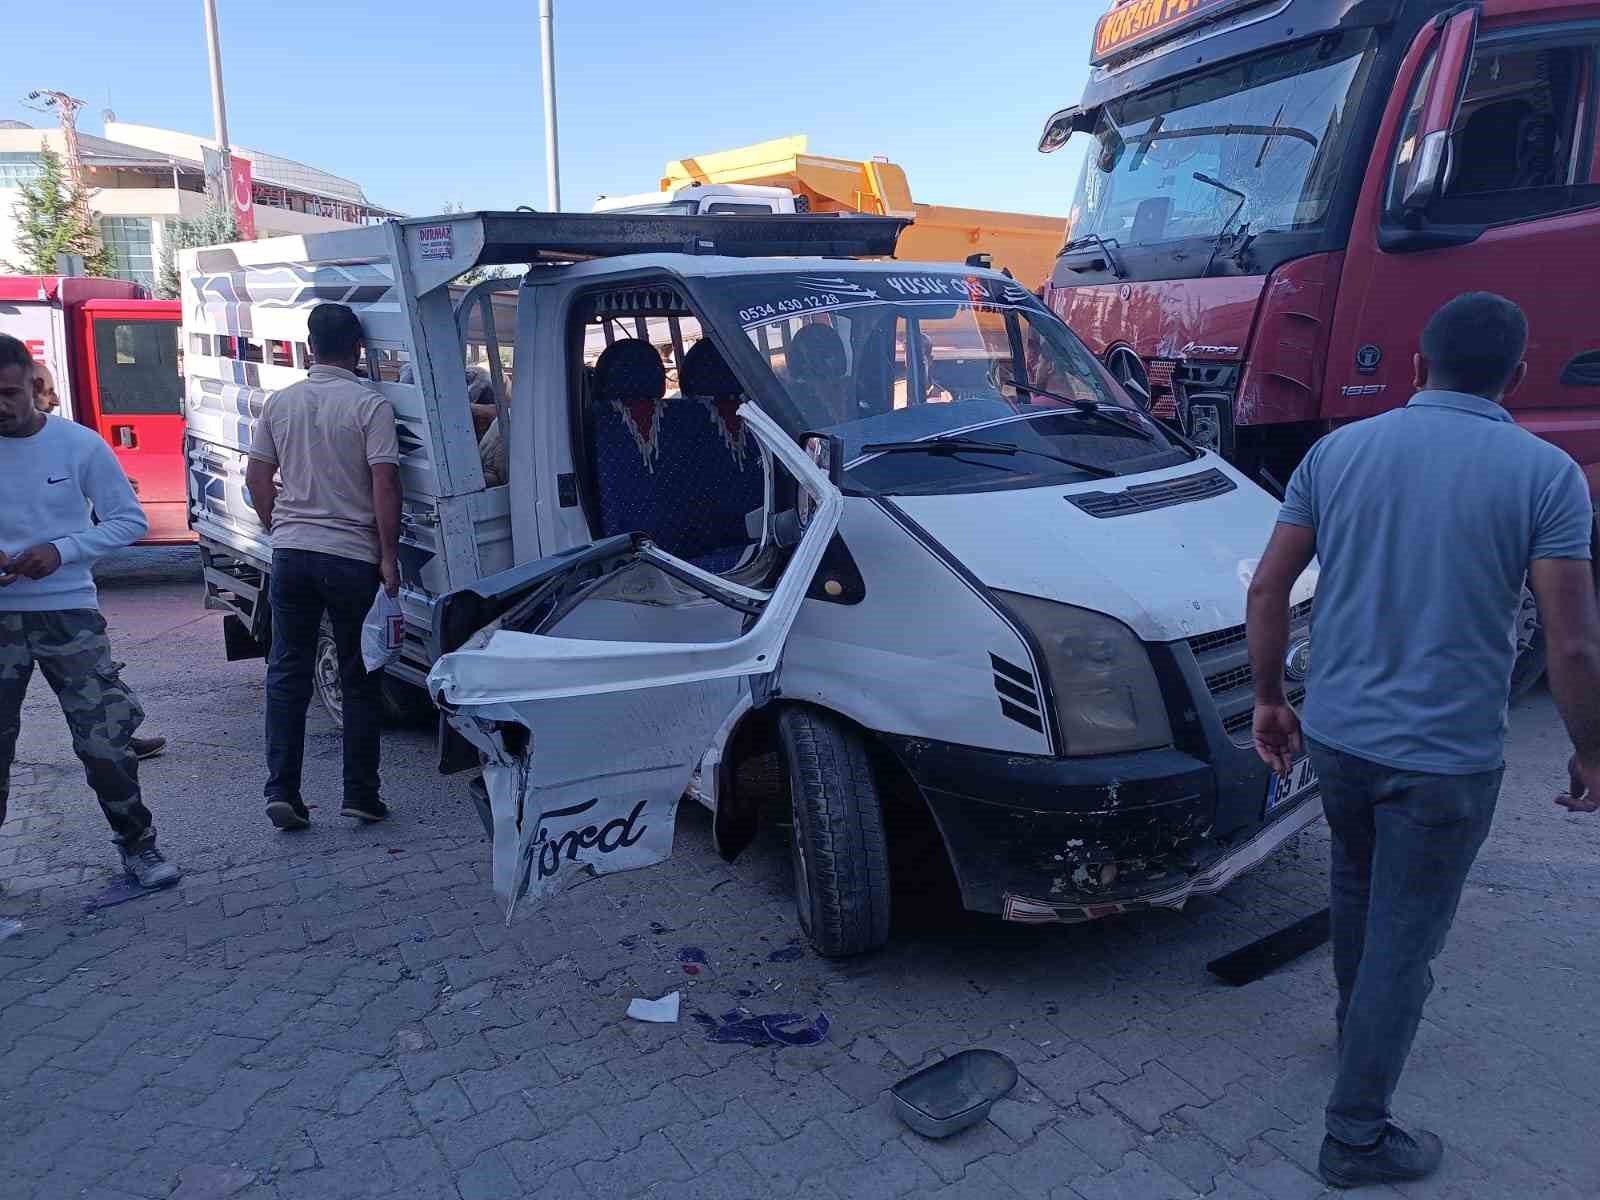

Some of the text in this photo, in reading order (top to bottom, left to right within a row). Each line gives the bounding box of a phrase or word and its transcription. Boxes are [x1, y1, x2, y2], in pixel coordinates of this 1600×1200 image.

[886, 276, 949, 295] YUSUF
[739, 303, 776, 321] 0534
[778, 299, 803, 312] 430
[804, 296, 822, 307] 12
